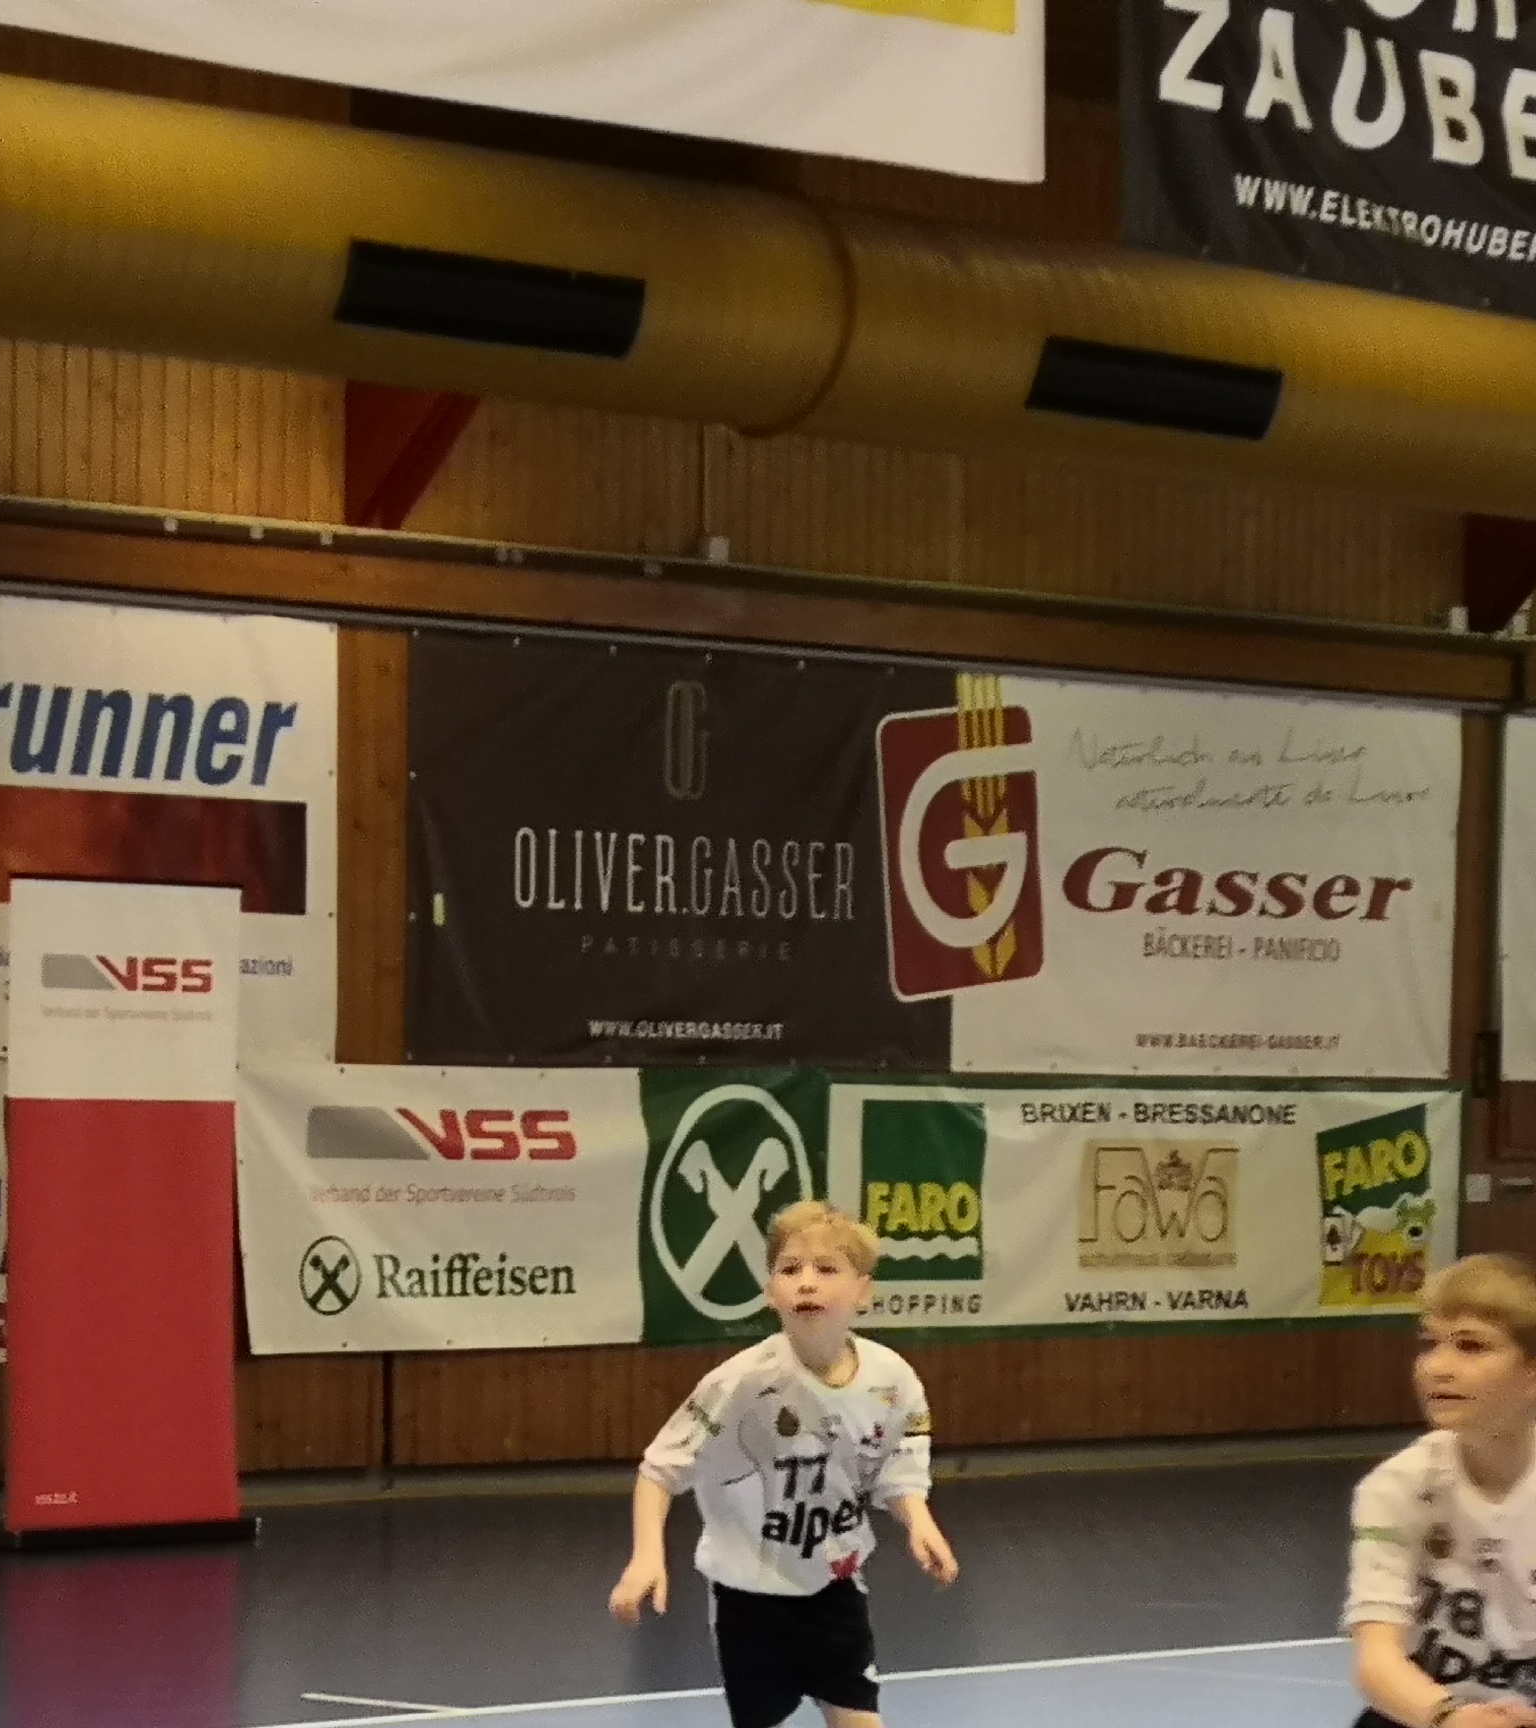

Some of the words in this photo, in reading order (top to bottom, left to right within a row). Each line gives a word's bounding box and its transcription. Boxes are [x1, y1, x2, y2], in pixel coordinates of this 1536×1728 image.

[1062, 845, 1415, 923] Gasser
[96, 954, 213, 993] VSS
[395, 1107, 578, 1161] VSS
[1021, 1101, 1112, 1125] BRIXEN
[1133, 1101, 1298, 1126] BRESSANONE
[1322, 1129, 1431, 1200] FARO
[867, 1181, 980, 1234] FARO
[373, 1251, 577, 1299] Raiffeisen
[1065, 1291, 1147, 1313] VAHRN
[1166, 1289, 1249, 1311] VARNA
